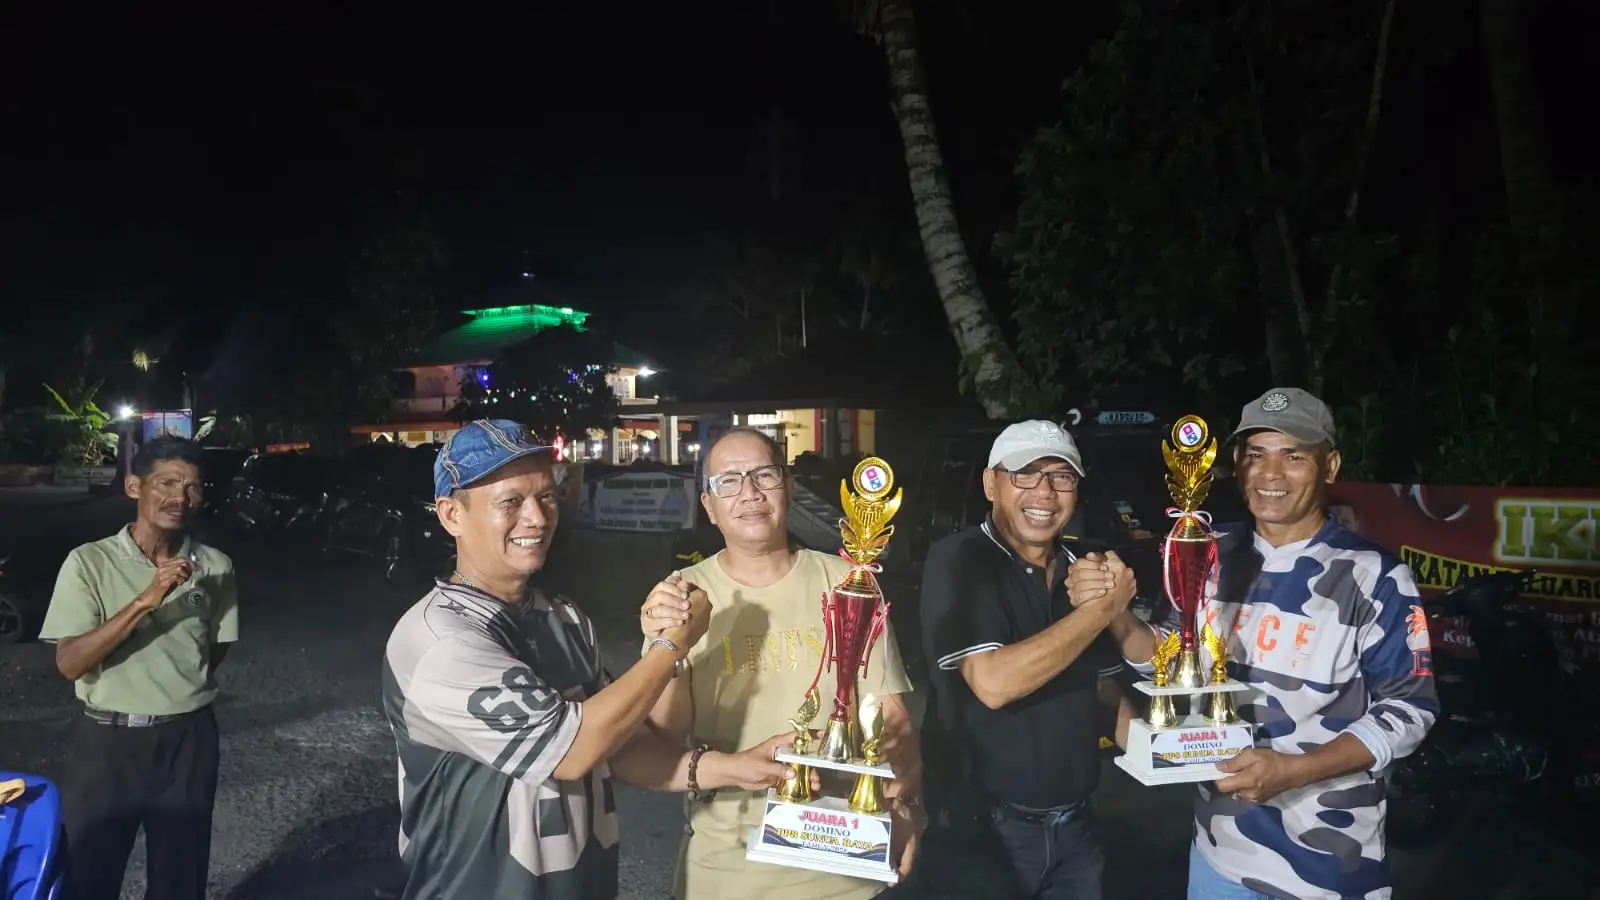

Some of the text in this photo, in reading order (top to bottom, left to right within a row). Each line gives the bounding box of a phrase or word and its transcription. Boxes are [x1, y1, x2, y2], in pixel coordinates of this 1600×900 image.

[1498, 502, 1600, 559] IK
[467, 666, 562, 733] 68
[1178, 730, 1228, 743] JUARA 1
[1183, 742, 1222, 751] DOMINO
[798, 810, 860, 830] JUARA 1
[803, 823, 851, 837] DOMINO
